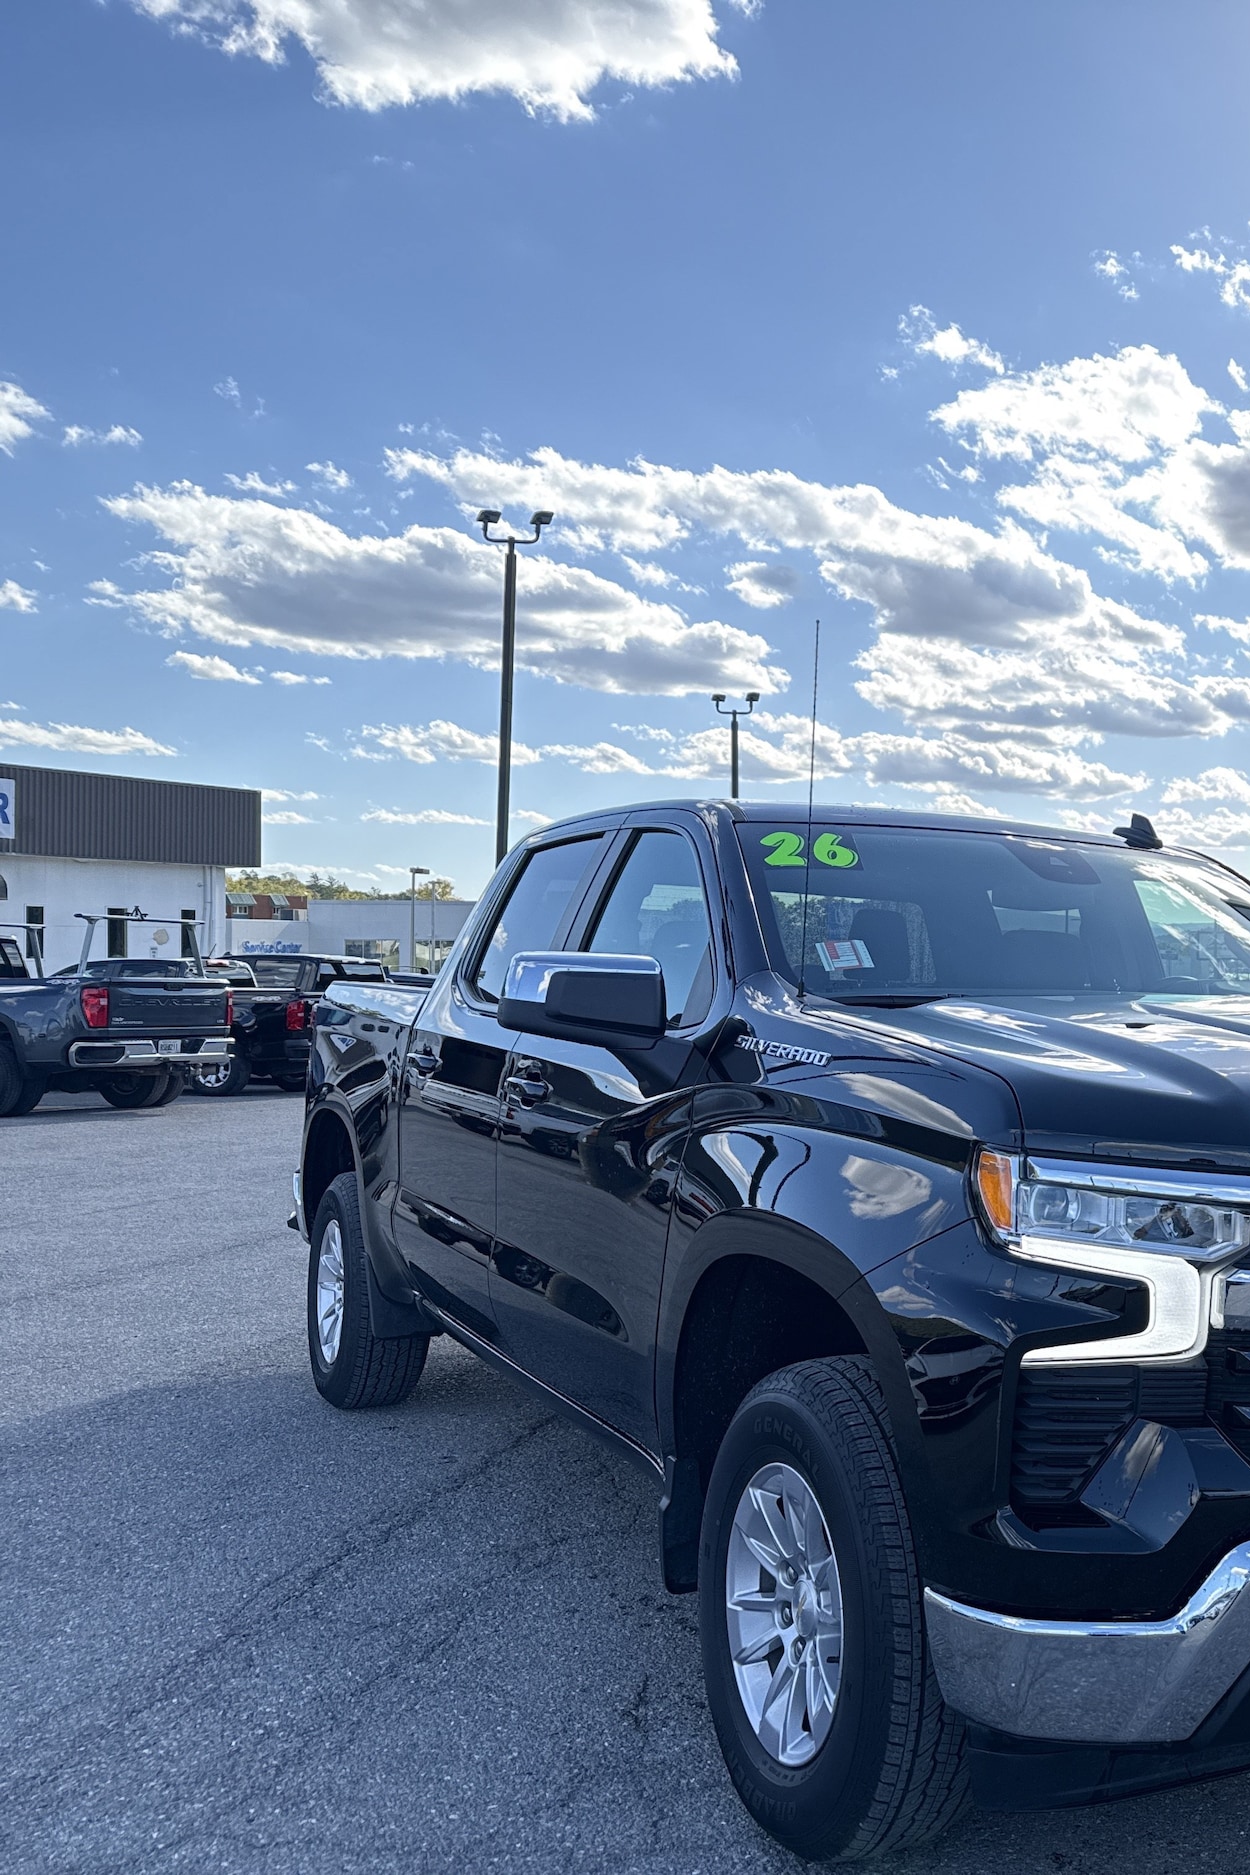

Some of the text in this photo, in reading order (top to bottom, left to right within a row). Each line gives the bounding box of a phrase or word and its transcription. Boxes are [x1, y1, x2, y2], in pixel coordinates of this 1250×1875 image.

[759, 831, 859, 869] 26
[241, 940, 303, 954] Service Center
[119, 998, 222, 1007] CHEVROLET
[734, 1034, 832, 1068] SILVERADO
